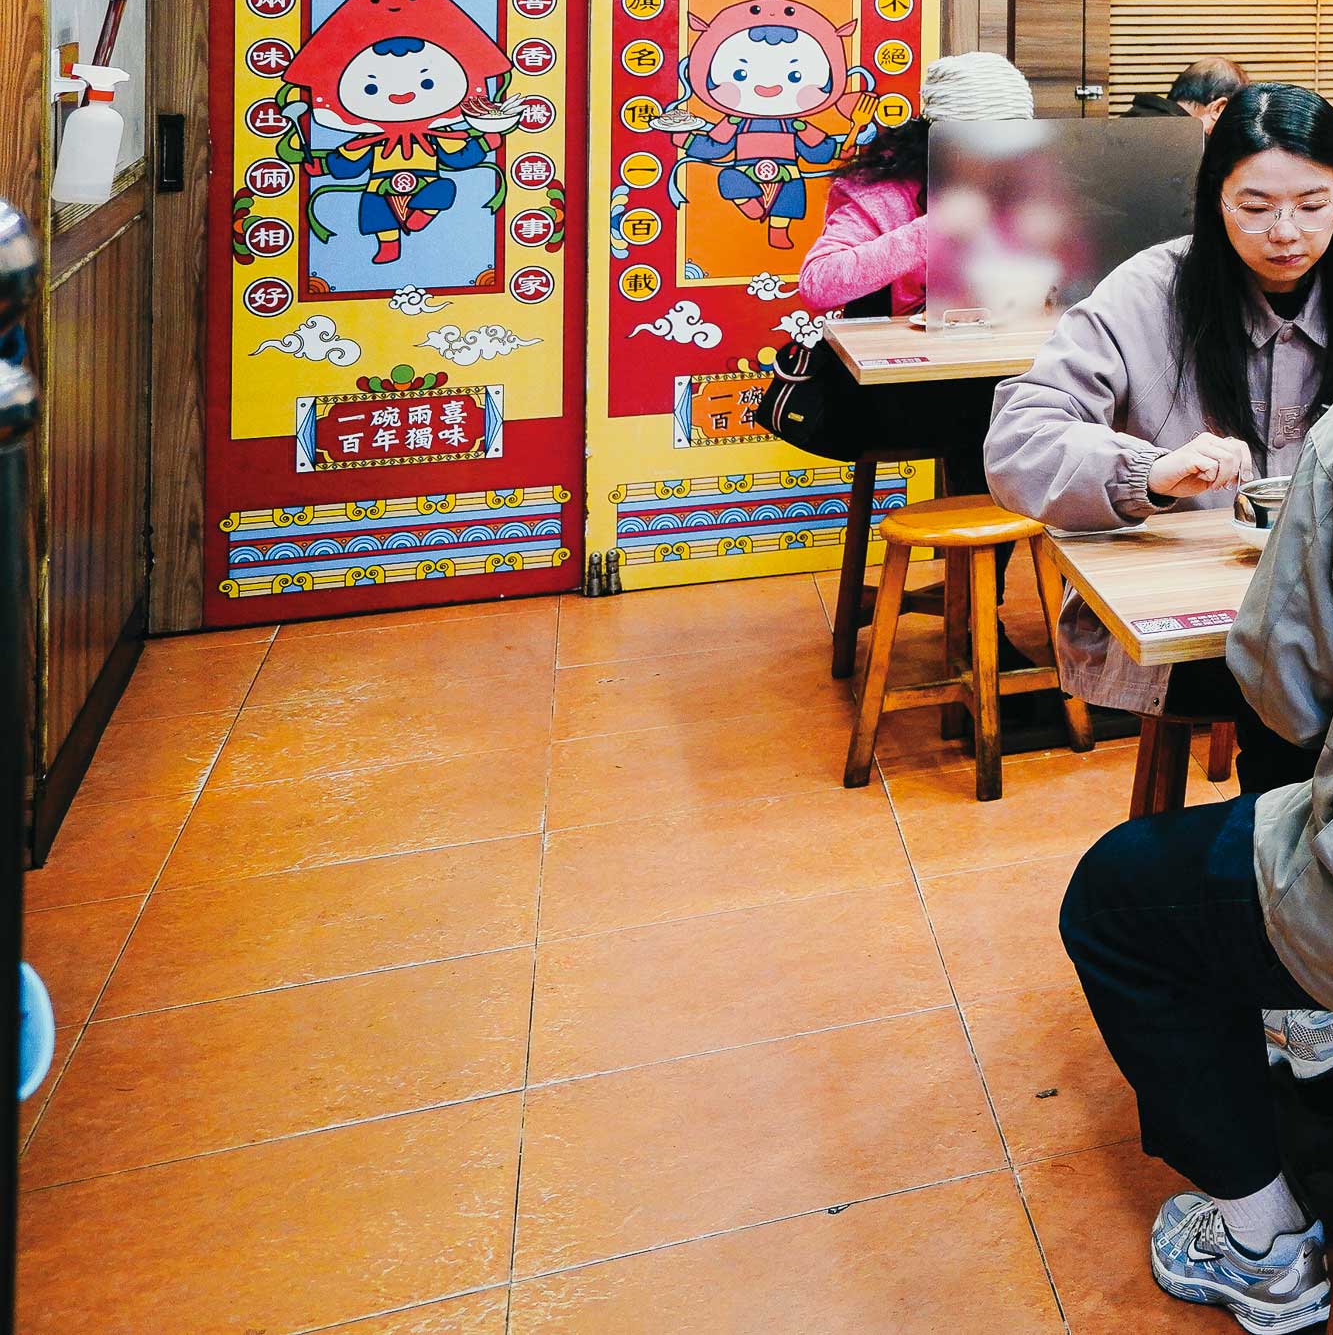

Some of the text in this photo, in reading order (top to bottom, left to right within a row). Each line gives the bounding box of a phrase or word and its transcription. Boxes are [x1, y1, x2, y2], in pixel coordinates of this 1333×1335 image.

[337, 400, 468, 428] 一碗兩喜
[338, 424, 469, 454] 百年獨味
